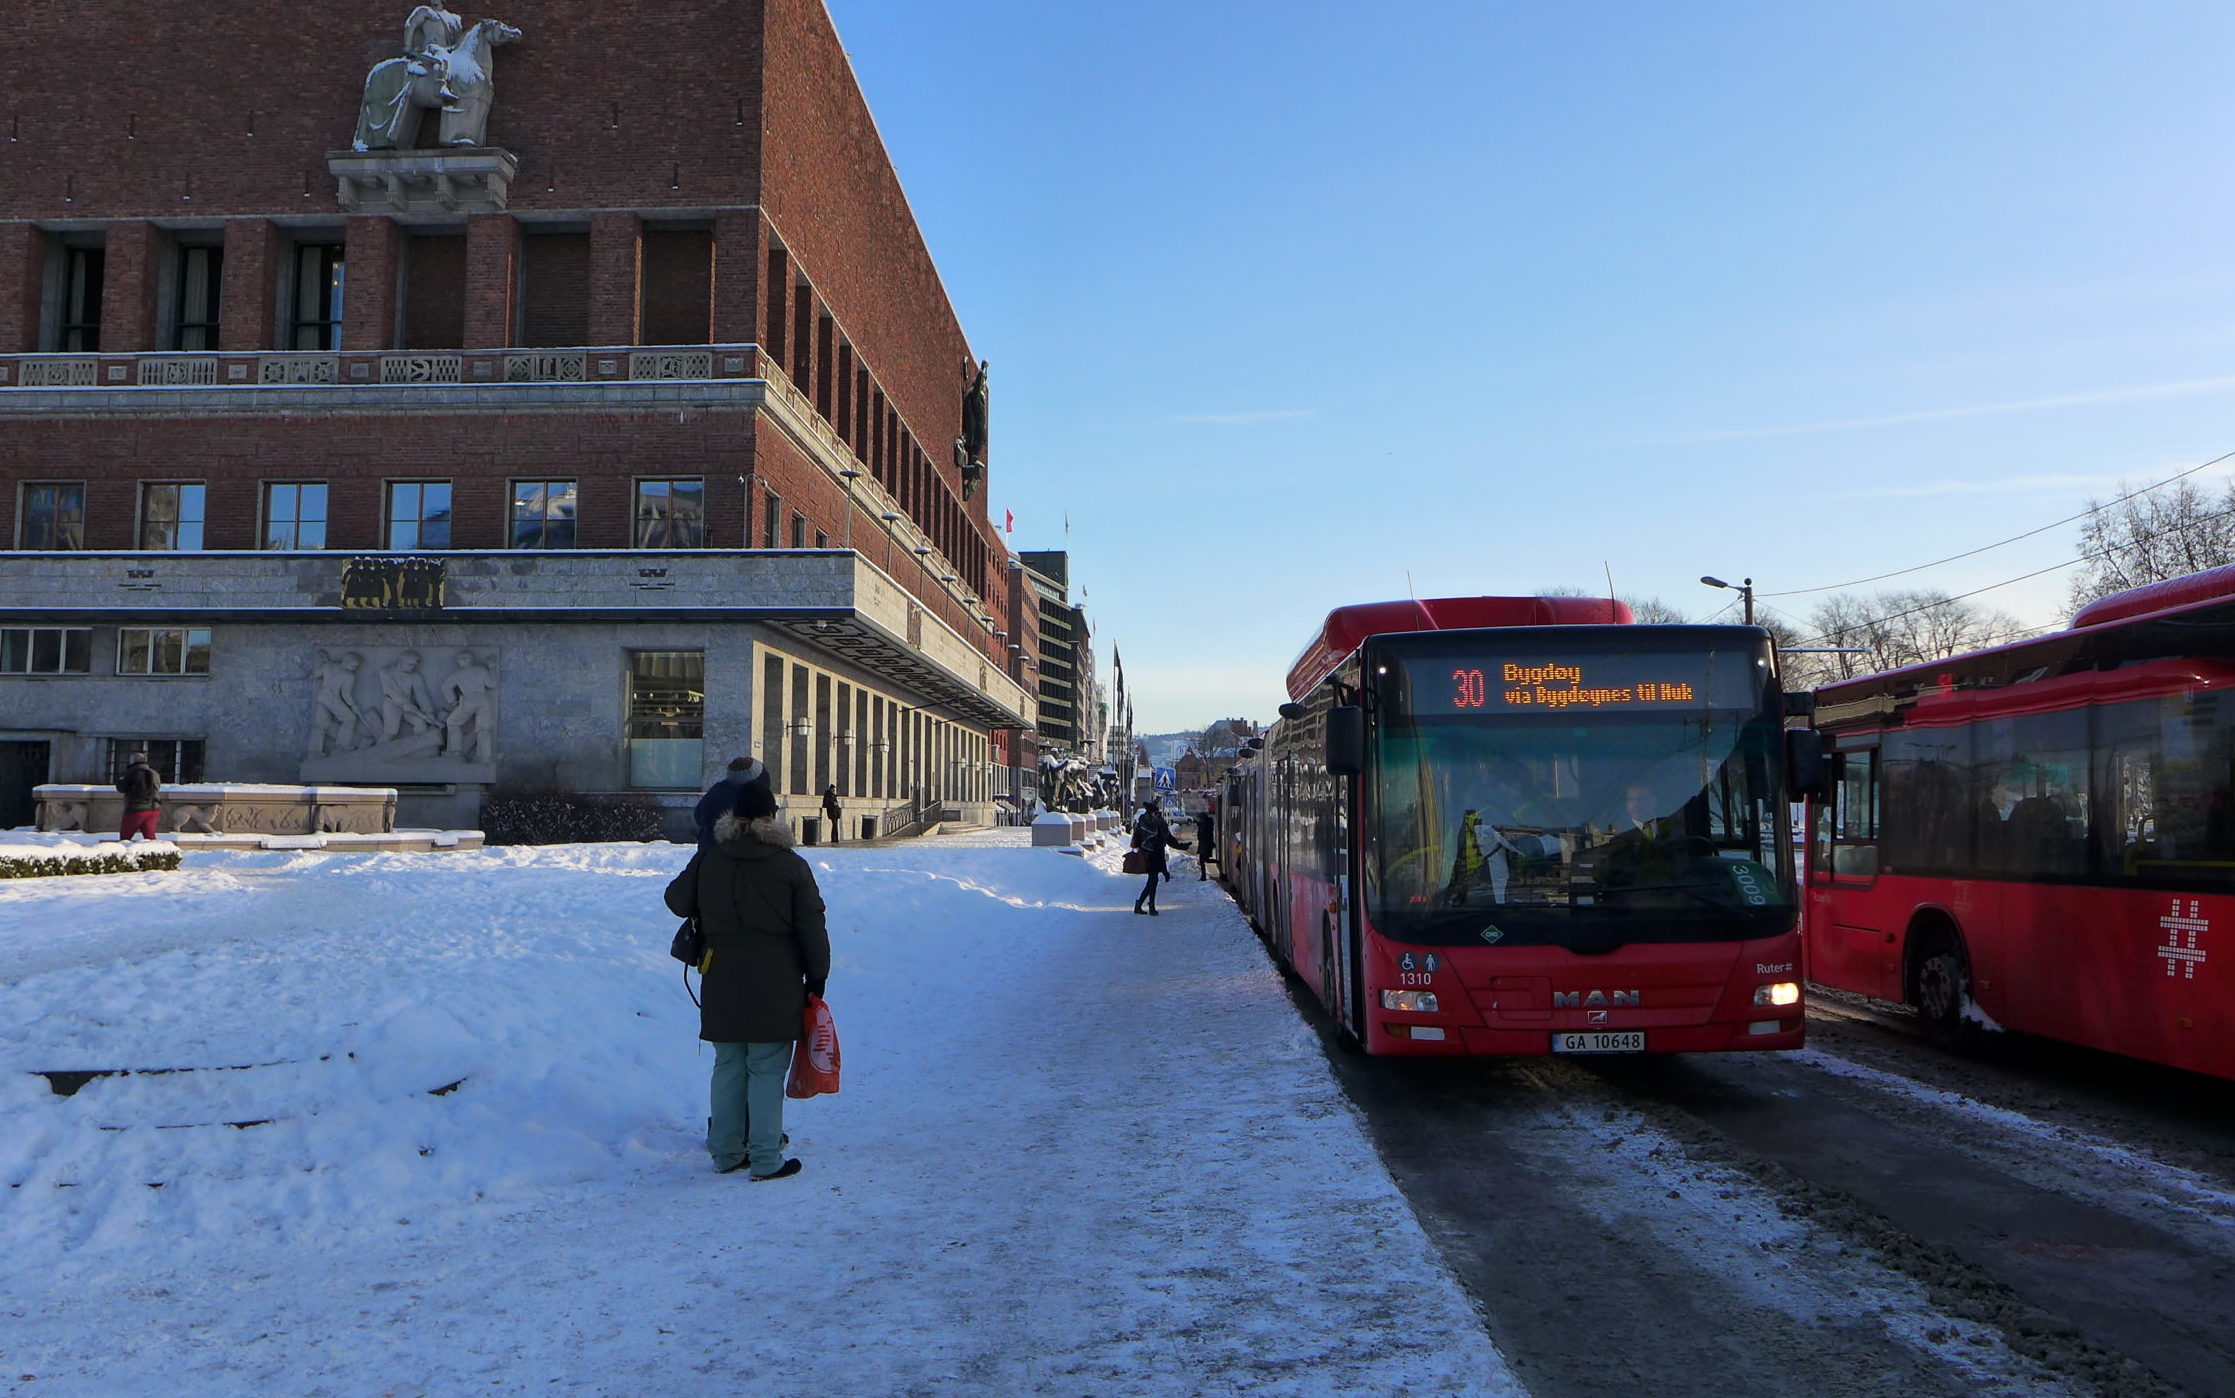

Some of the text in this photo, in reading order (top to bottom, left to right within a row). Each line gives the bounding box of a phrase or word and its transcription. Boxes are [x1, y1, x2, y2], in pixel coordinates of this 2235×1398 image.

[1504, 663, 1581, 685] Bygdøy
[1453, 669, 1485, 707] 30
[1504, 683, 1693, 707] via Bygdøynes til Huk
[1732, 865, 1766, 906] 3009
[1400, 972, 1432, 985] 1310
[1553, 989, 1640, 1009] MAN
[1565, 1034, 1641, 1050] GA 10648
